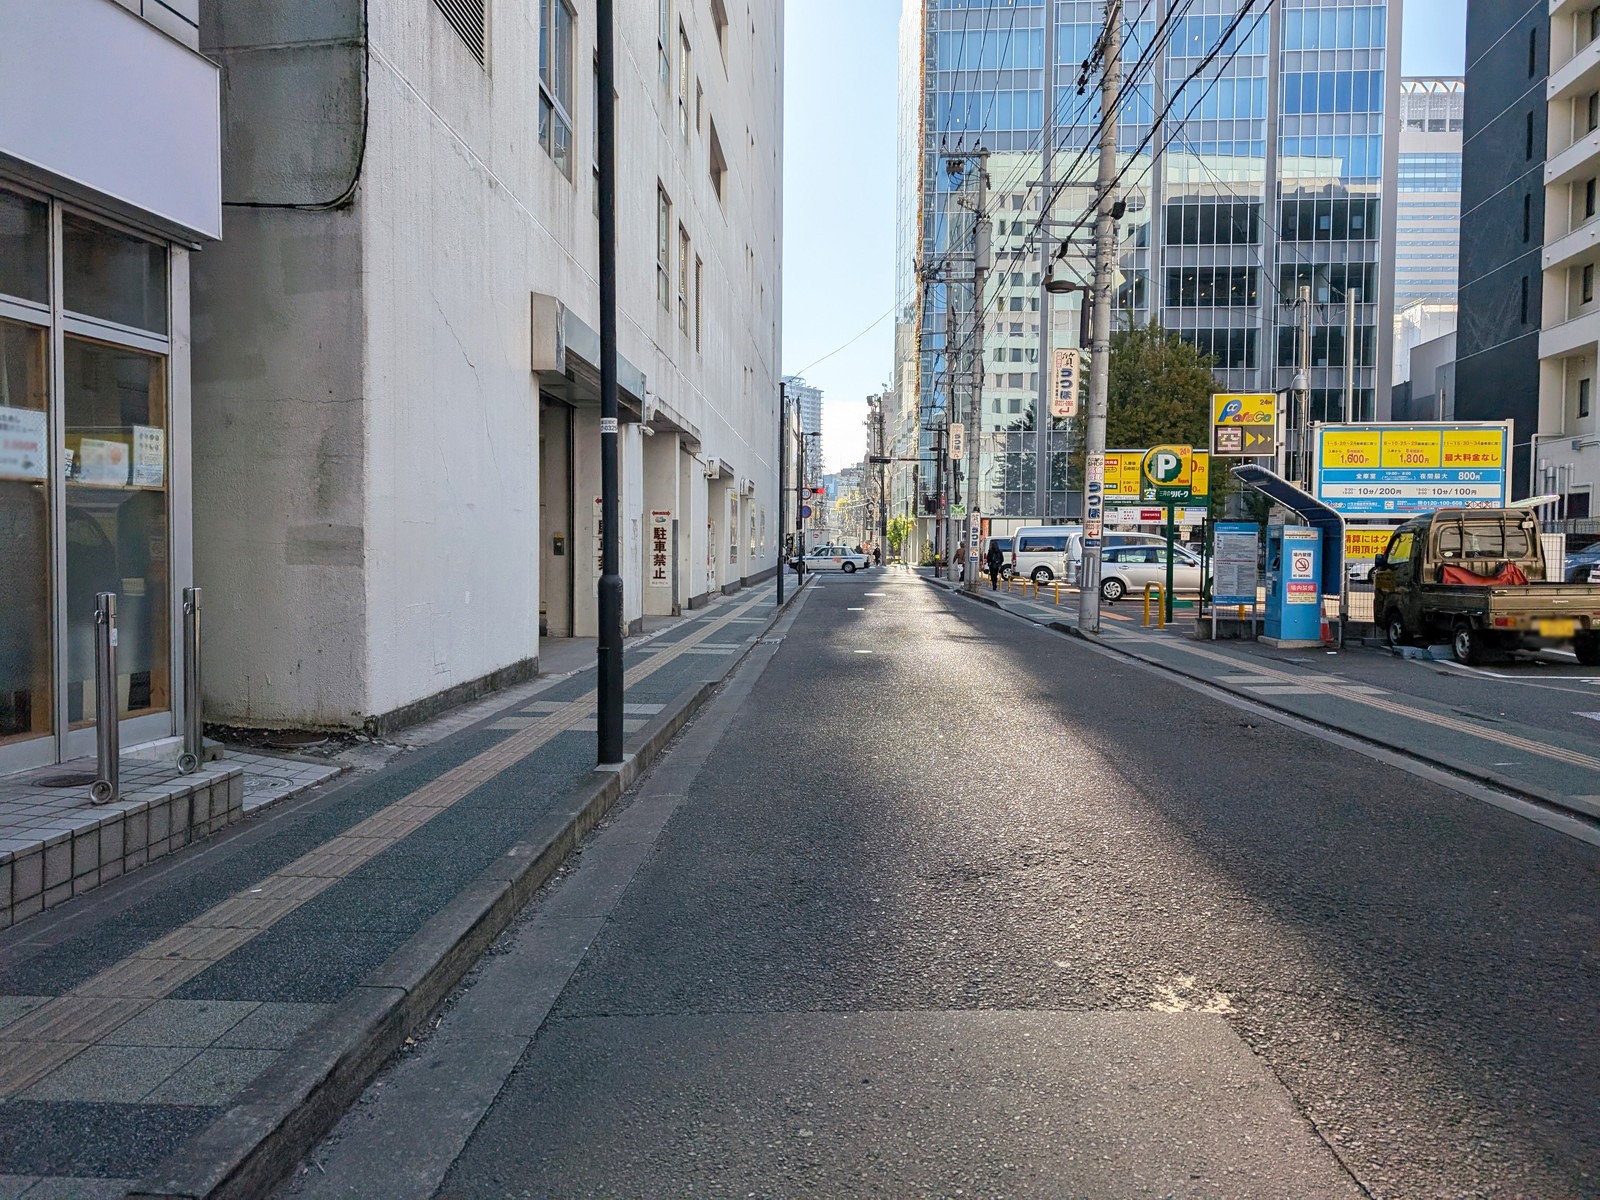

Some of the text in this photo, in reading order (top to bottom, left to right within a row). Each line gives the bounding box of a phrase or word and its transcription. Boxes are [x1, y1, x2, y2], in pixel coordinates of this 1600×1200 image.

[1444, 453, 1499, 462] 最大料金なし
[653, 527, 667, 580] 駐車禁止
